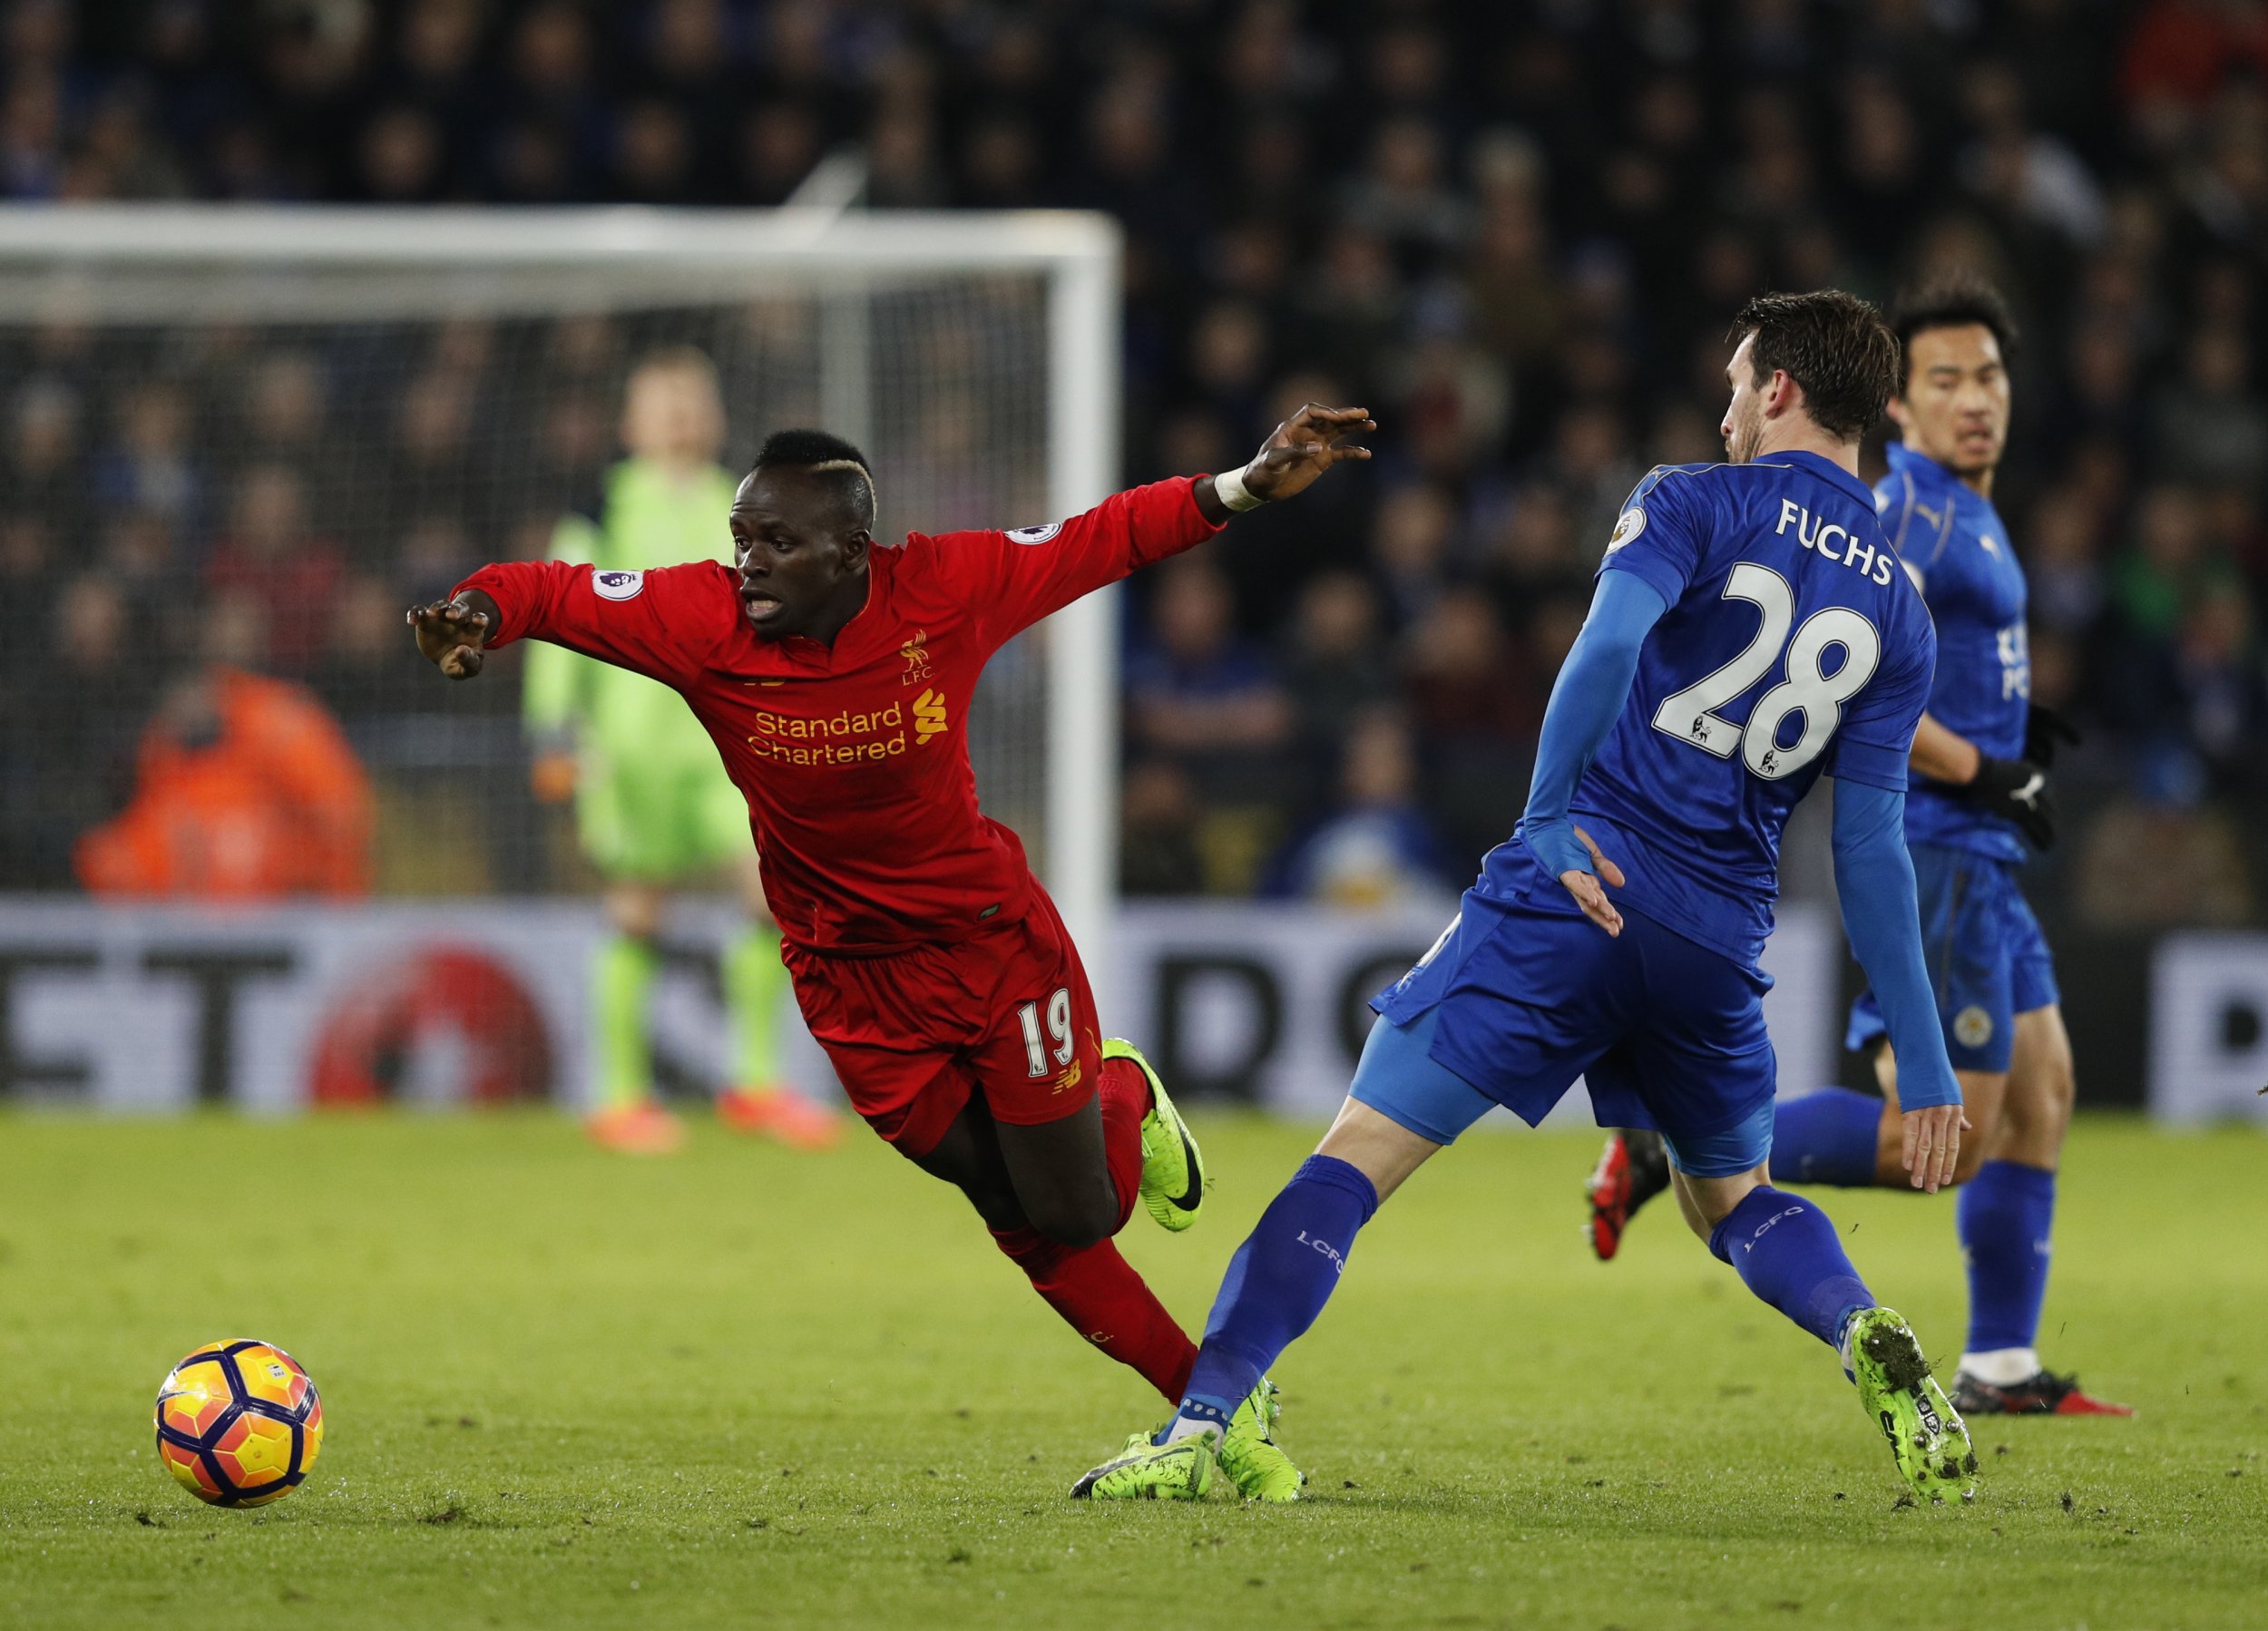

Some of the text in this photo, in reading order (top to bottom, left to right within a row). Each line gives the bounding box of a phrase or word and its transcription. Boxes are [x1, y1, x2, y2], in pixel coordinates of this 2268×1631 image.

[1775, 498, 1893, 586] FUCHS
[1651, 562, 1881, 780] 28
[748, 730, 905, 766] Chartered
[756, 701, 902, 737] Standard
[1018, 988, 1074, 1078] 19
